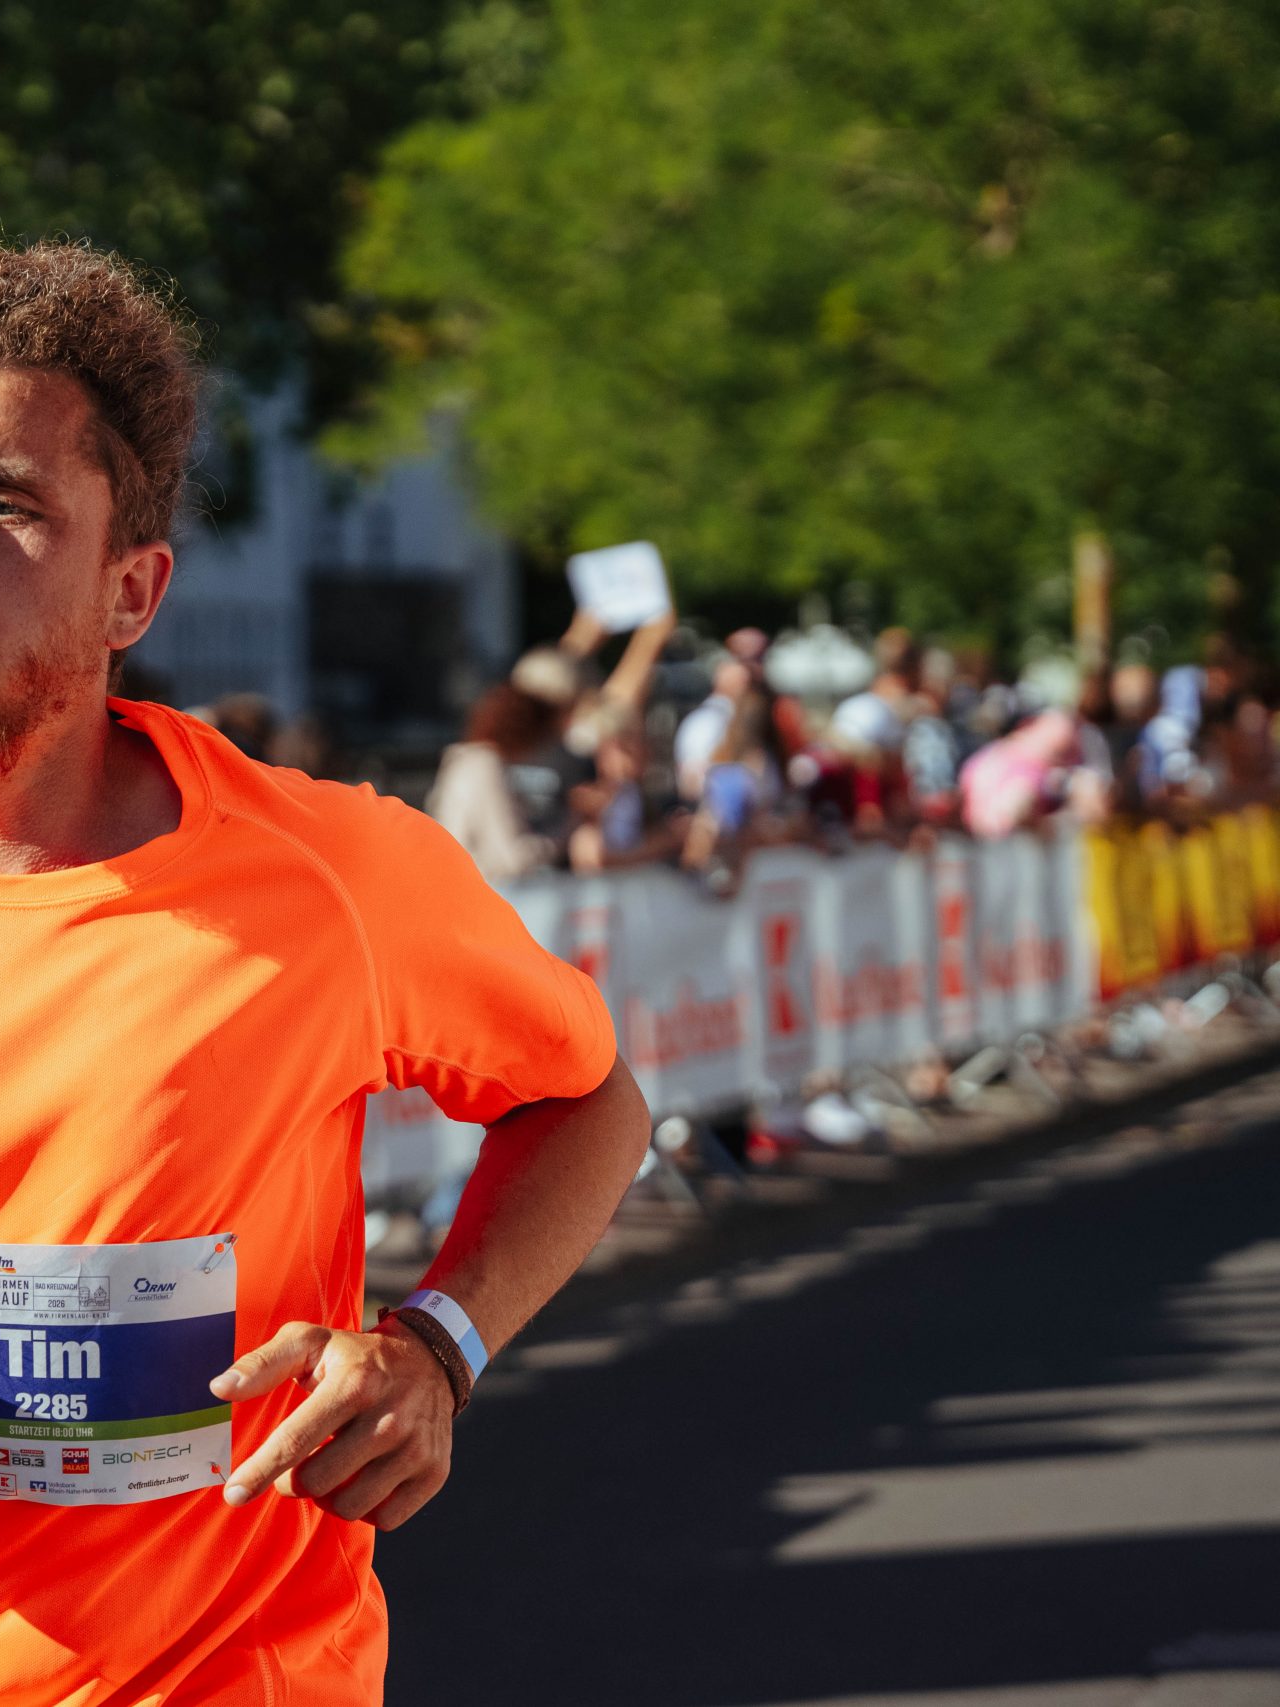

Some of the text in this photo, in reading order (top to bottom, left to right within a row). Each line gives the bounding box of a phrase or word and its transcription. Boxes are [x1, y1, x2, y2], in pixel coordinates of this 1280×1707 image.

[47, 1283, 78, 1291] KREUZNACH
[47, 1299, 66, 1308] 2026
[0, 1328, 101, 1379] Tim
[14, 1392, 88, 1420] 2285
[9, 1424, 94, 1438] STARTZEIT 18:00 UHR
[62, 1450, 89, 1459] SCHUH
[102, 1443, 192, 1465] BIONTECH
[12, 1456, 45, 1468] 88.3
[62, 1464, 88, 1472] PALAST
